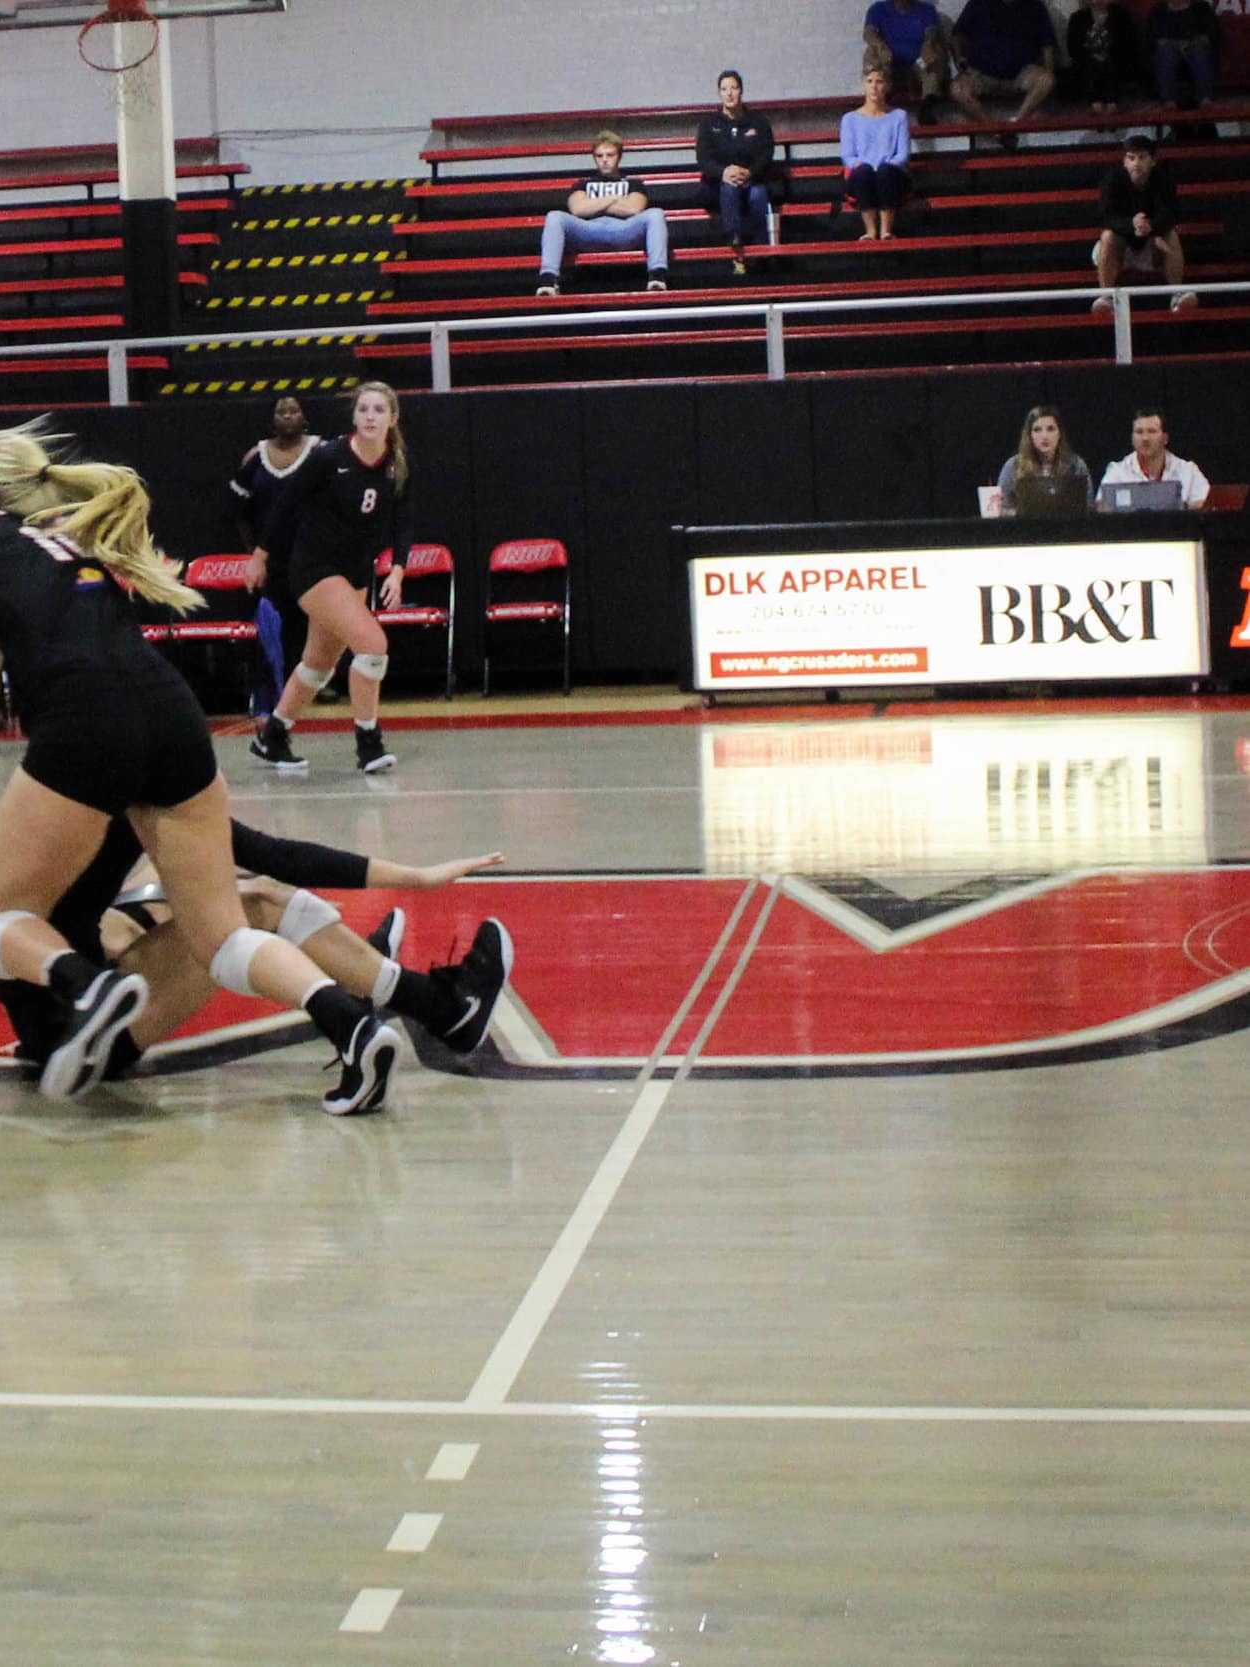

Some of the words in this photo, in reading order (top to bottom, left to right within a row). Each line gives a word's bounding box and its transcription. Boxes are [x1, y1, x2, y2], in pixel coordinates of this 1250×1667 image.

[361, 488, 378, 513] 8
[703, 570, 768, 597] DLK
[778, 566, 928, 594] APPAREL
[974, 577, 1176, 646] BB&T
[720, 652, 918, 674] www.ngcrusaders.com
